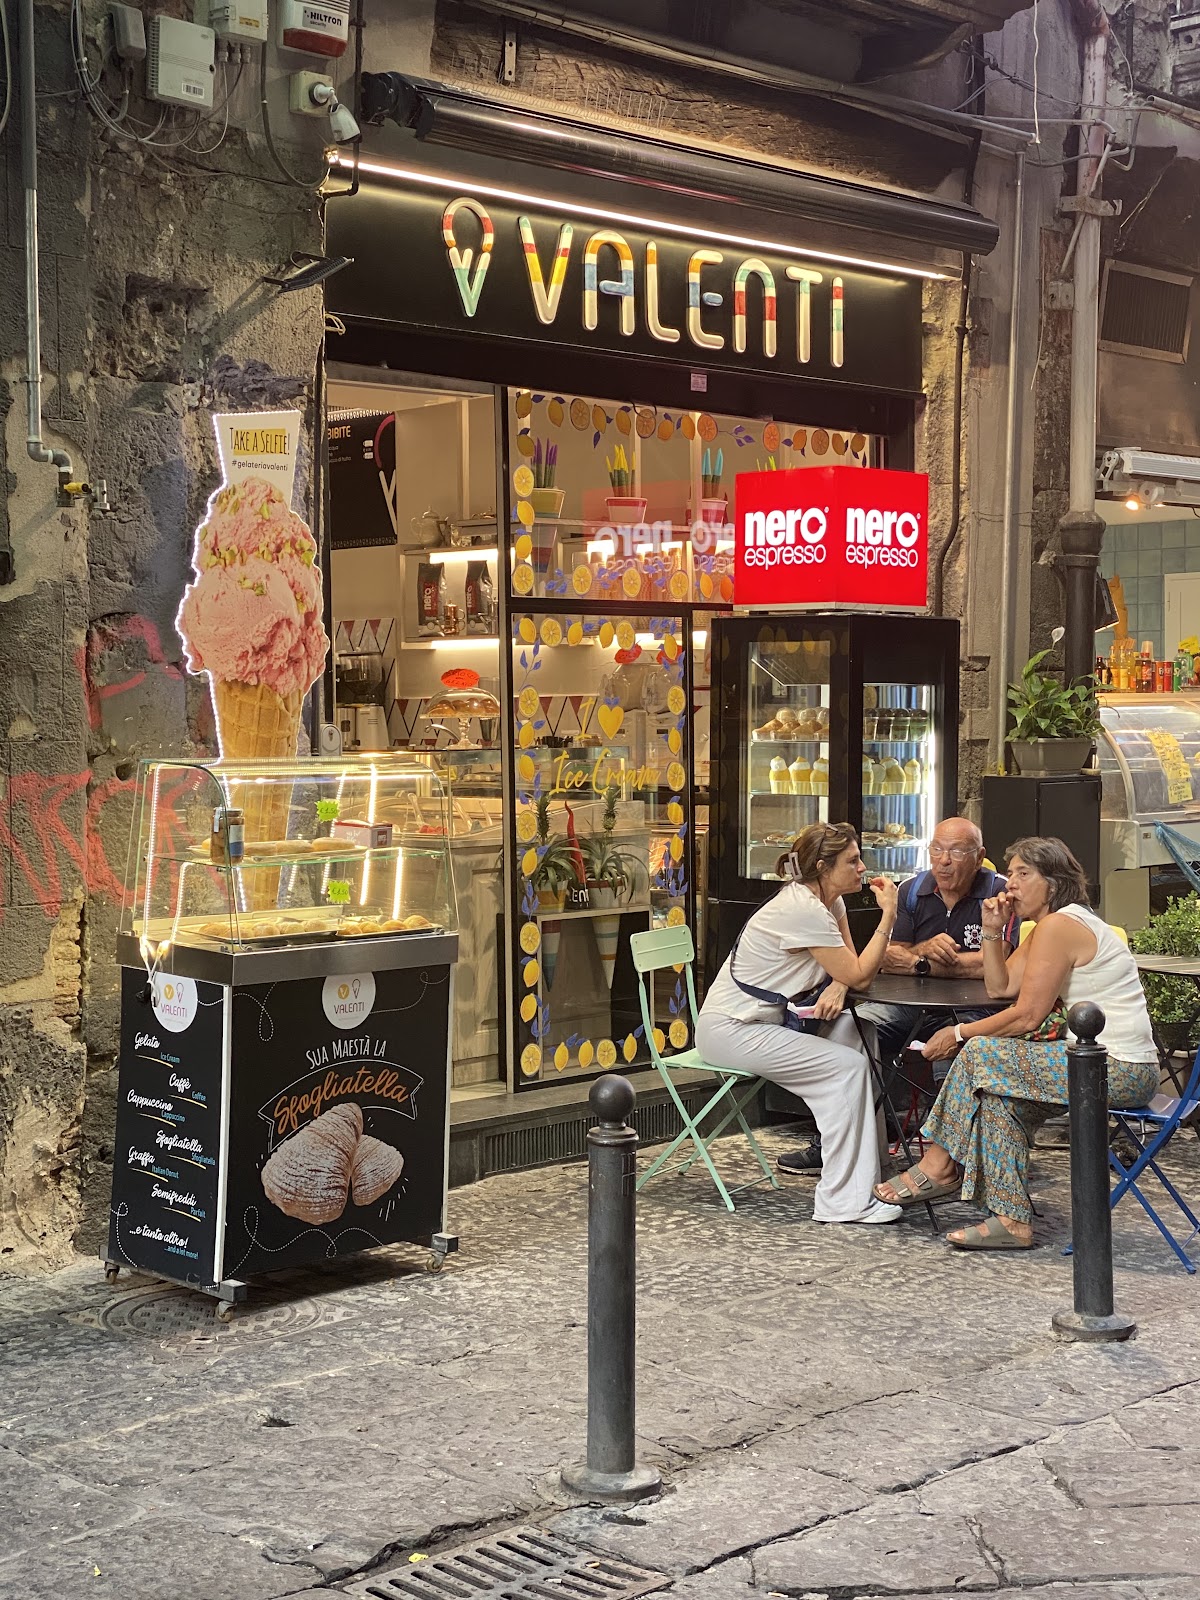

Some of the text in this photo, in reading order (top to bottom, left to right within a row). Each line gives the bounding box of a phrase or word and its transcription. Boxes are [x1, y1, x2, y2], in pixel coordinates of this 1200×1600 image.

[518, 213, 844, 368] VALENTI
[229, 427, 250, 451] TAKE
[231, 460, 288, 471] #gelateriavalenti
[744, 544, 827, 570] espresso
[846, 544, 918, 569] espresso
[424, 587, 432, 610] nero
[549, 748, 661, 796] Ice Cream
[161, 1003, 188, 1018] VALENTI
[333, 1001, 365, 1014] VALENTI
[135, 1031, 160, 1049] Gelato
[305, 1035, 387, 1069] SUA MAESTÀ LA
[169, 1073, 191, 1093] Caffè
[127, 1089, 174, 1111] Cappuccino
[273, 1066, 409, 1134] Sfogliatella
[155, 1129, 203, 1153] Sfogliatella
[127, 1146, 155, 1167] Graffa
[151, 1183, 197, 1206] Semifreddi
[141, 1224, 163, 1241] tanto
[164, 1231, 189, 1248] altro!
